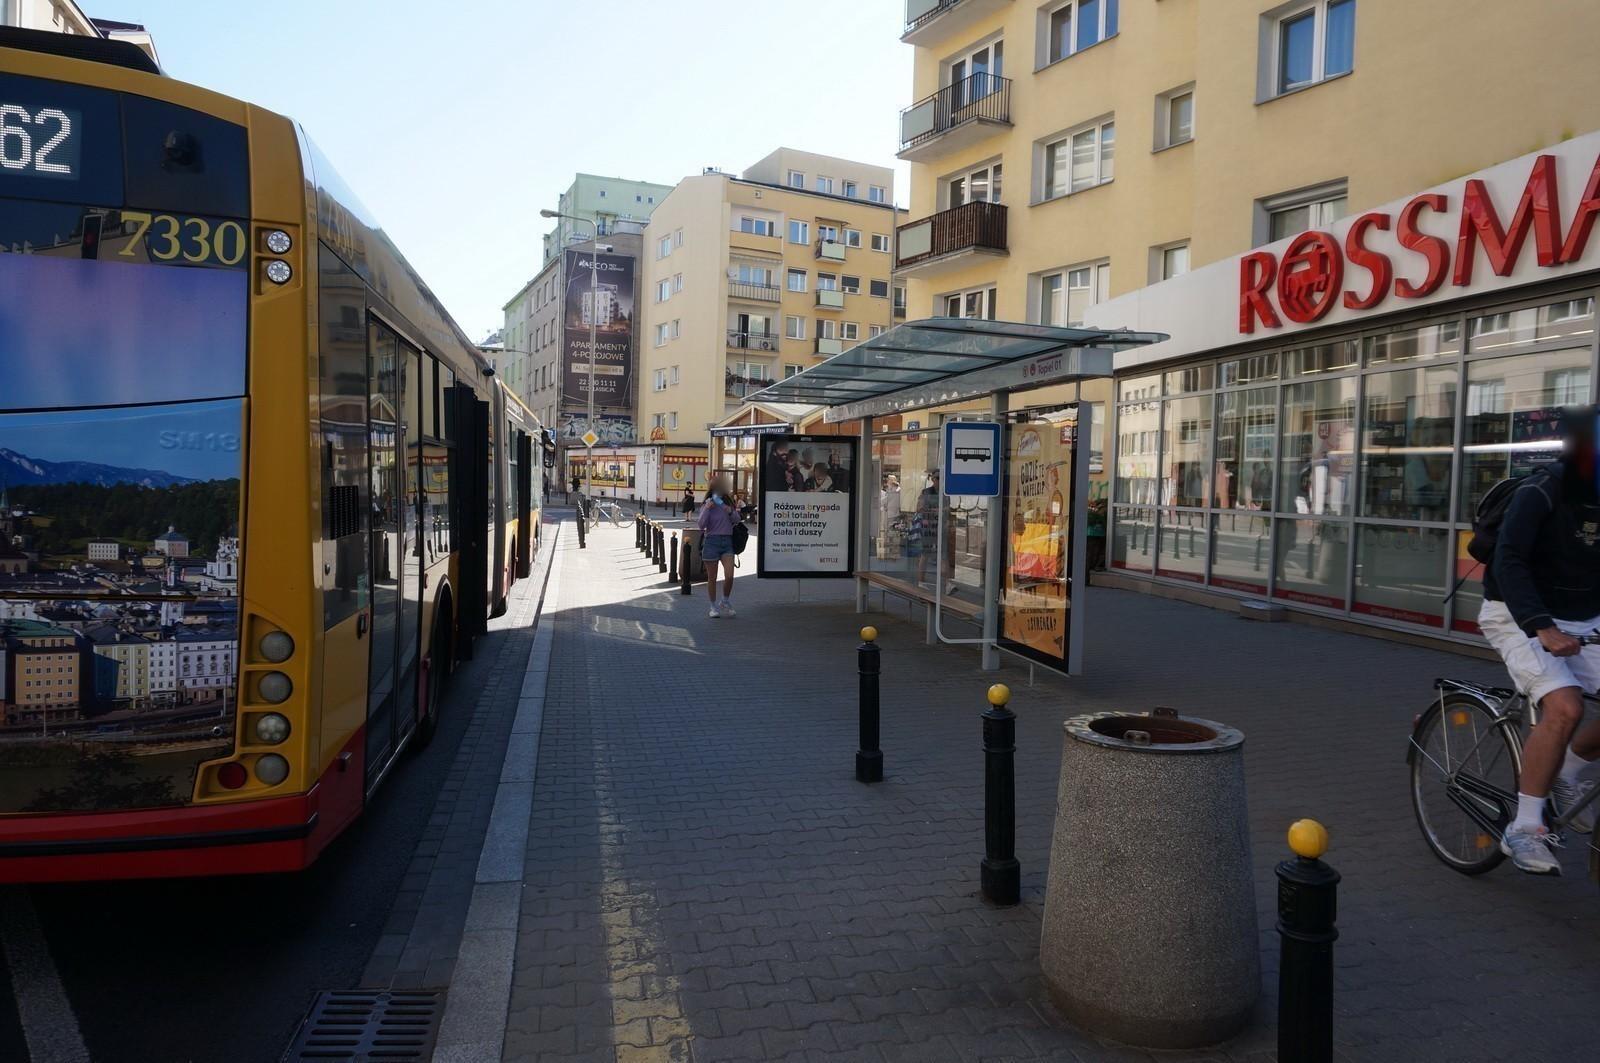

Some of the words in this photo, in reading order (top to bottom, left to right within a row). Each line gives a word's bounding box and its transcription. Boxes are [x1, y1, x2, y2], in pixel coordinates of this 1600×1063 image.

[118, 211, 246, 265] 7330
[570, 341, 627, 351] APARAMENTY
[1038, 360, 1054, 376] Topiel
[1020, 460, 1038, 485] GDZIE
[773, 502, 805, 511] Różowa
[808, 503, 840, 512] brygada
[773, 520, 827, 529] metamorfozy
[773, 528, 793, 536] ciała
[798, 528, 823, 537] duszy
